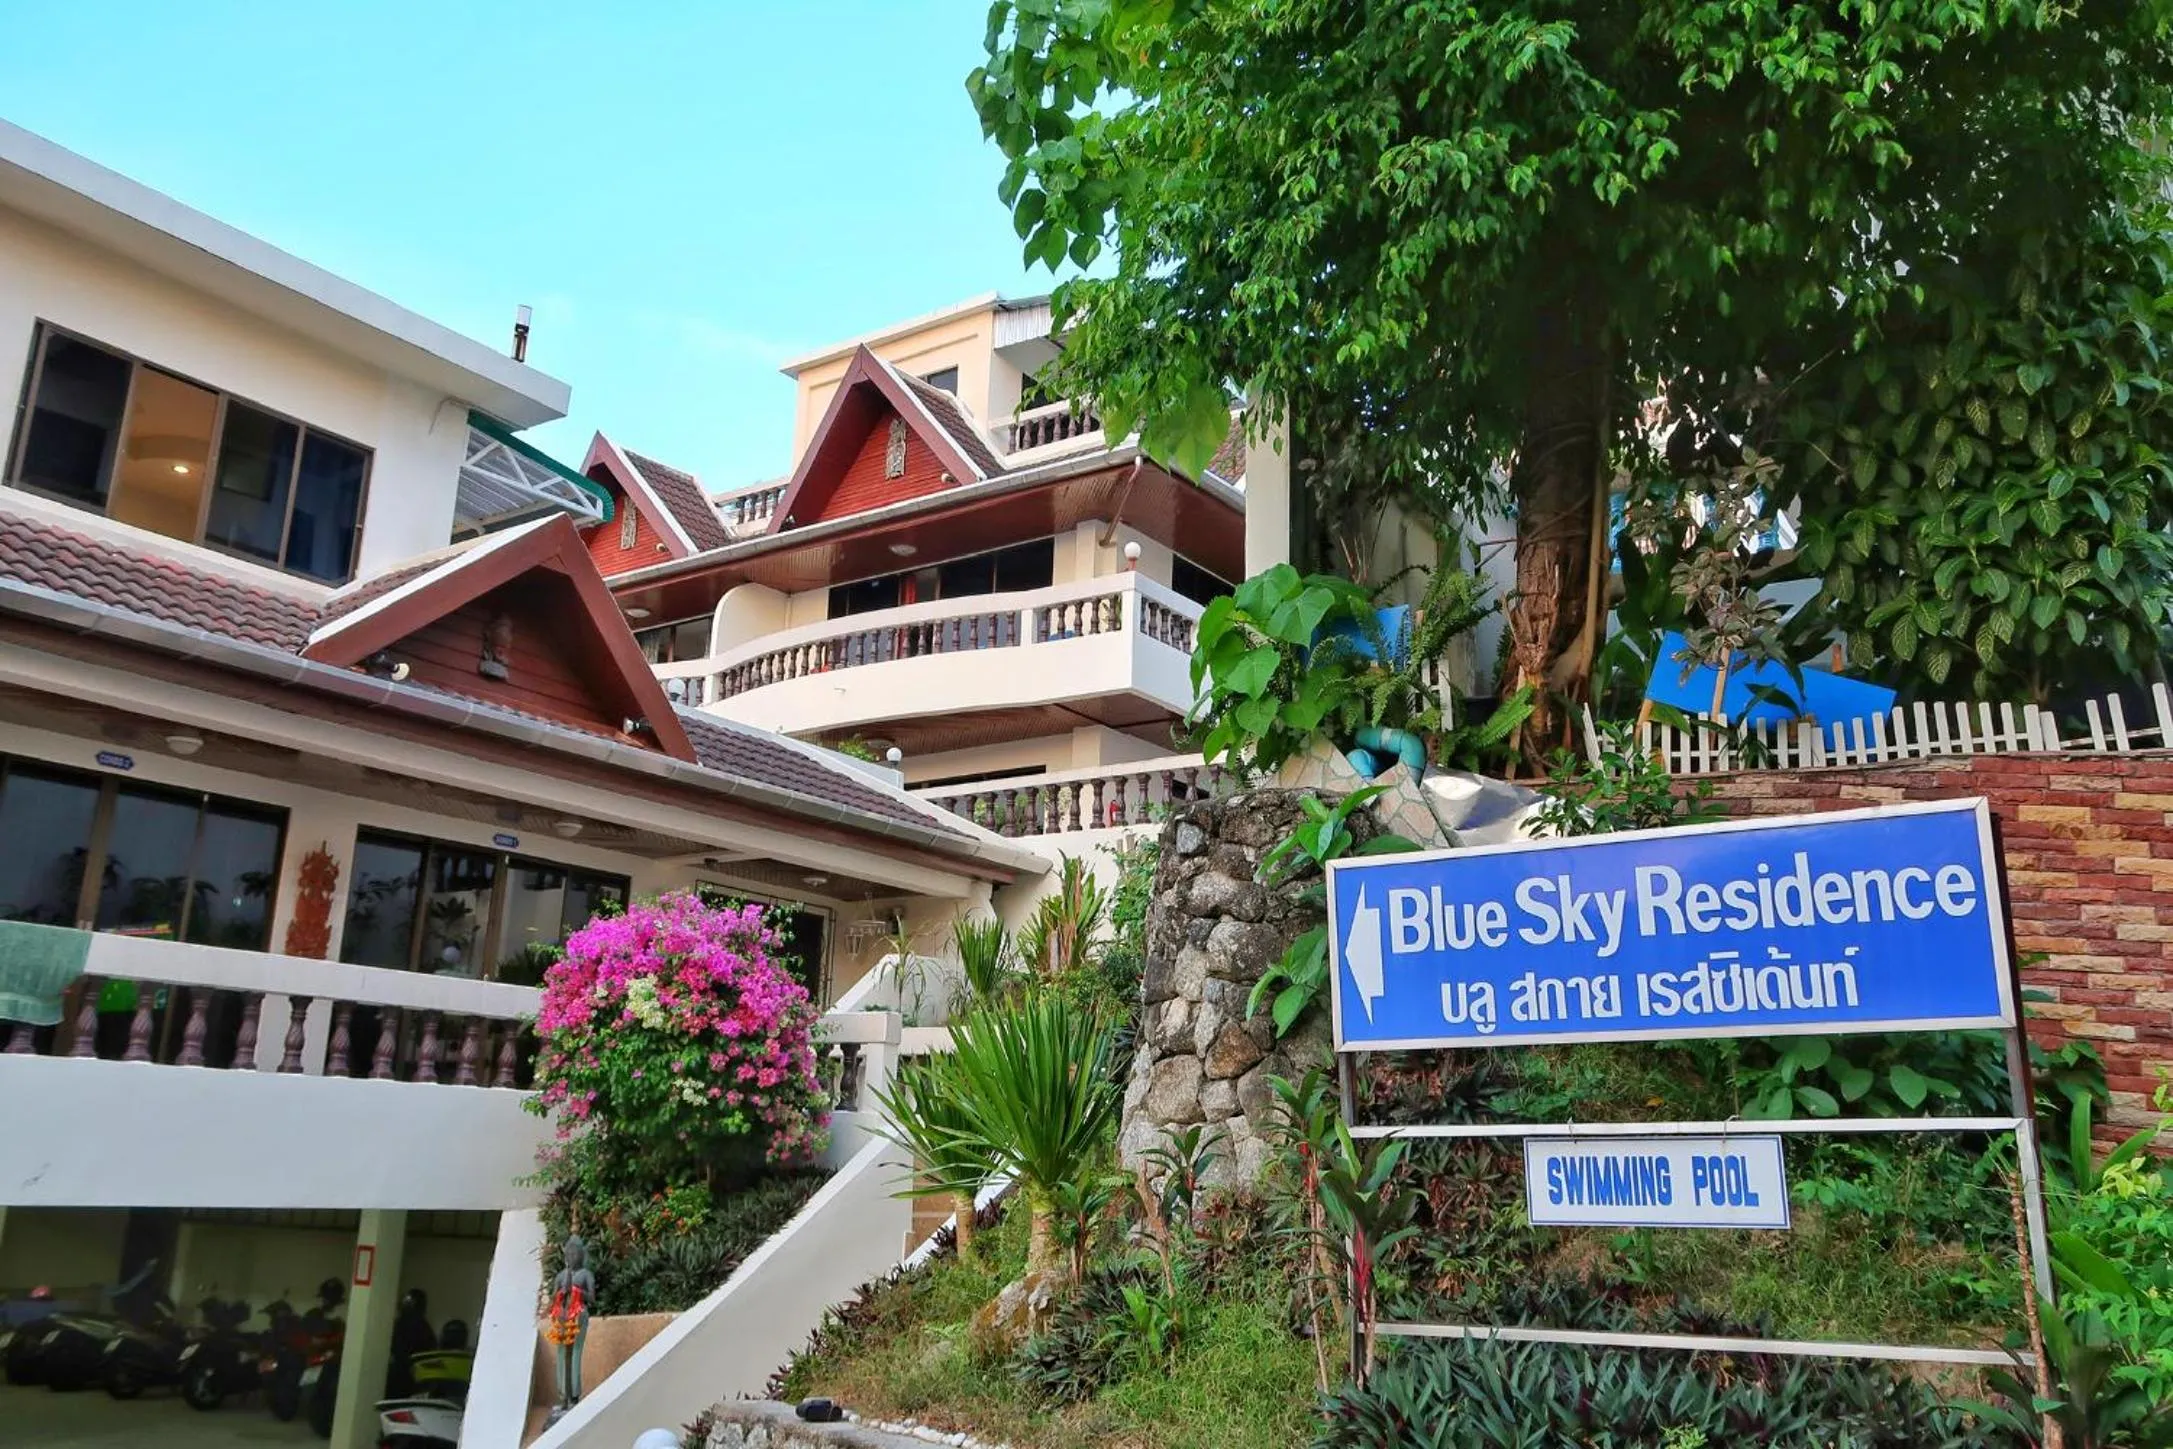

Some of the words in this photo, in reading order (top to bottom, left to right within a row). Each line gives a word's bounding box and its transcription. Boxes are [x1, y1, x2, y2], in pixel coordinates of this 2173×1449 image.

[1388, 885, 1509, 954] Blue
[1515, 876, 1628, 957] Sky
[1634, 851, 1976, 936] Residence
[1441, 980, 1496, 1033] บลู
[1509, 972, 1622, 1022] สกาย
[1636, 946, 1860, 1017] เรสซิเด้นท์
[1547, 1156, 1673, 1206] SWIMMING
[1691, 1155, 1760, 1206] POOL
